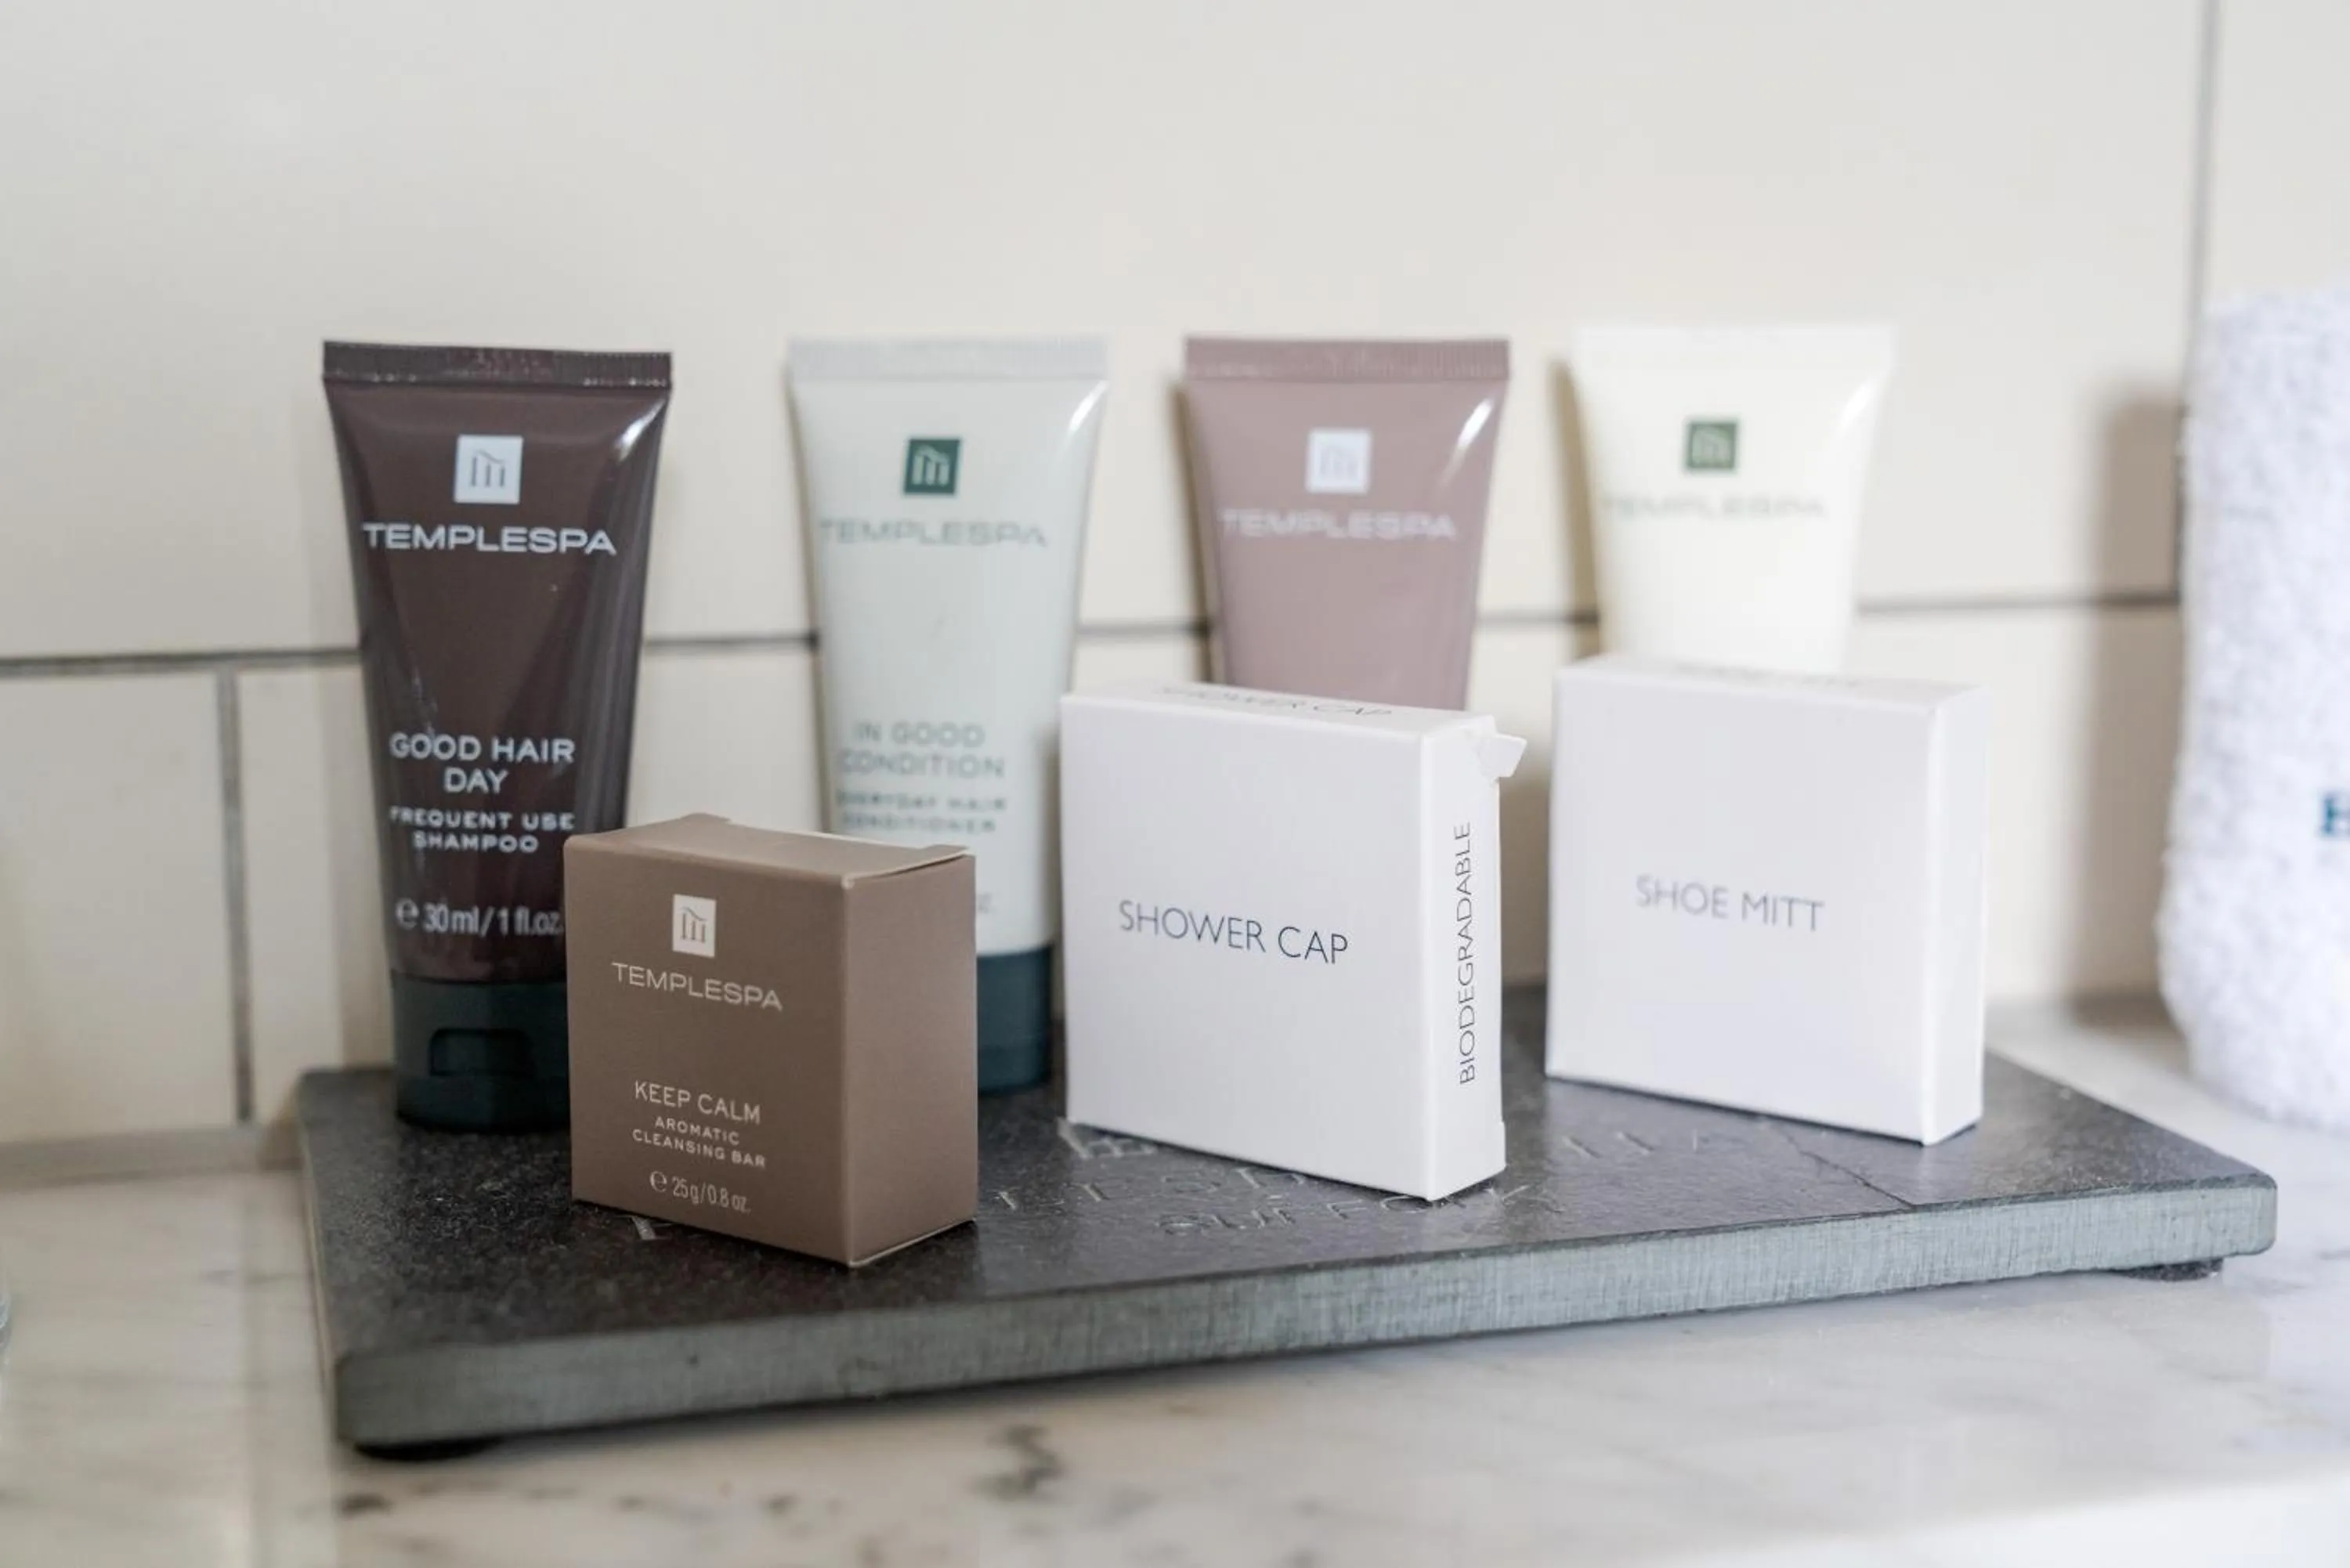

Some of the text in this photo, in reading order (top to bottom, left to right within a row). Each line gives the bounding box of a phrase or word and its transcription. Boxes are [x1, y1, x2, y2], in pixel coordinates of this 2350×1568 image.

[362, 522, 617, 556] TEMPLESPA
[1220, 508, 1457, 540] TEMPLESPA
[389, 732, 574, 764] GOOD HAIR
[891, 721, 985, 747] GOOD
[444, 768, 508, 793] DAY
[389, 807, 574, 831] FREQUENT USE
[414, 832, 538, 854] SHAMPOO
[1636, 875, 1826, 932] SHOE MITT
[1119, 900, 1349, 964] SHOWER CAP
[1453, 822, 1475, 1085] BIODEGRADABLE
[611, 962, 783, 1011] TEMPLESPA
[635, 1081, 761, 1123] KEEP CALM
[654, 1117, 740, 1145] AROMATIC
[632, 1129, 766, 1168] CLEANSING BAR
